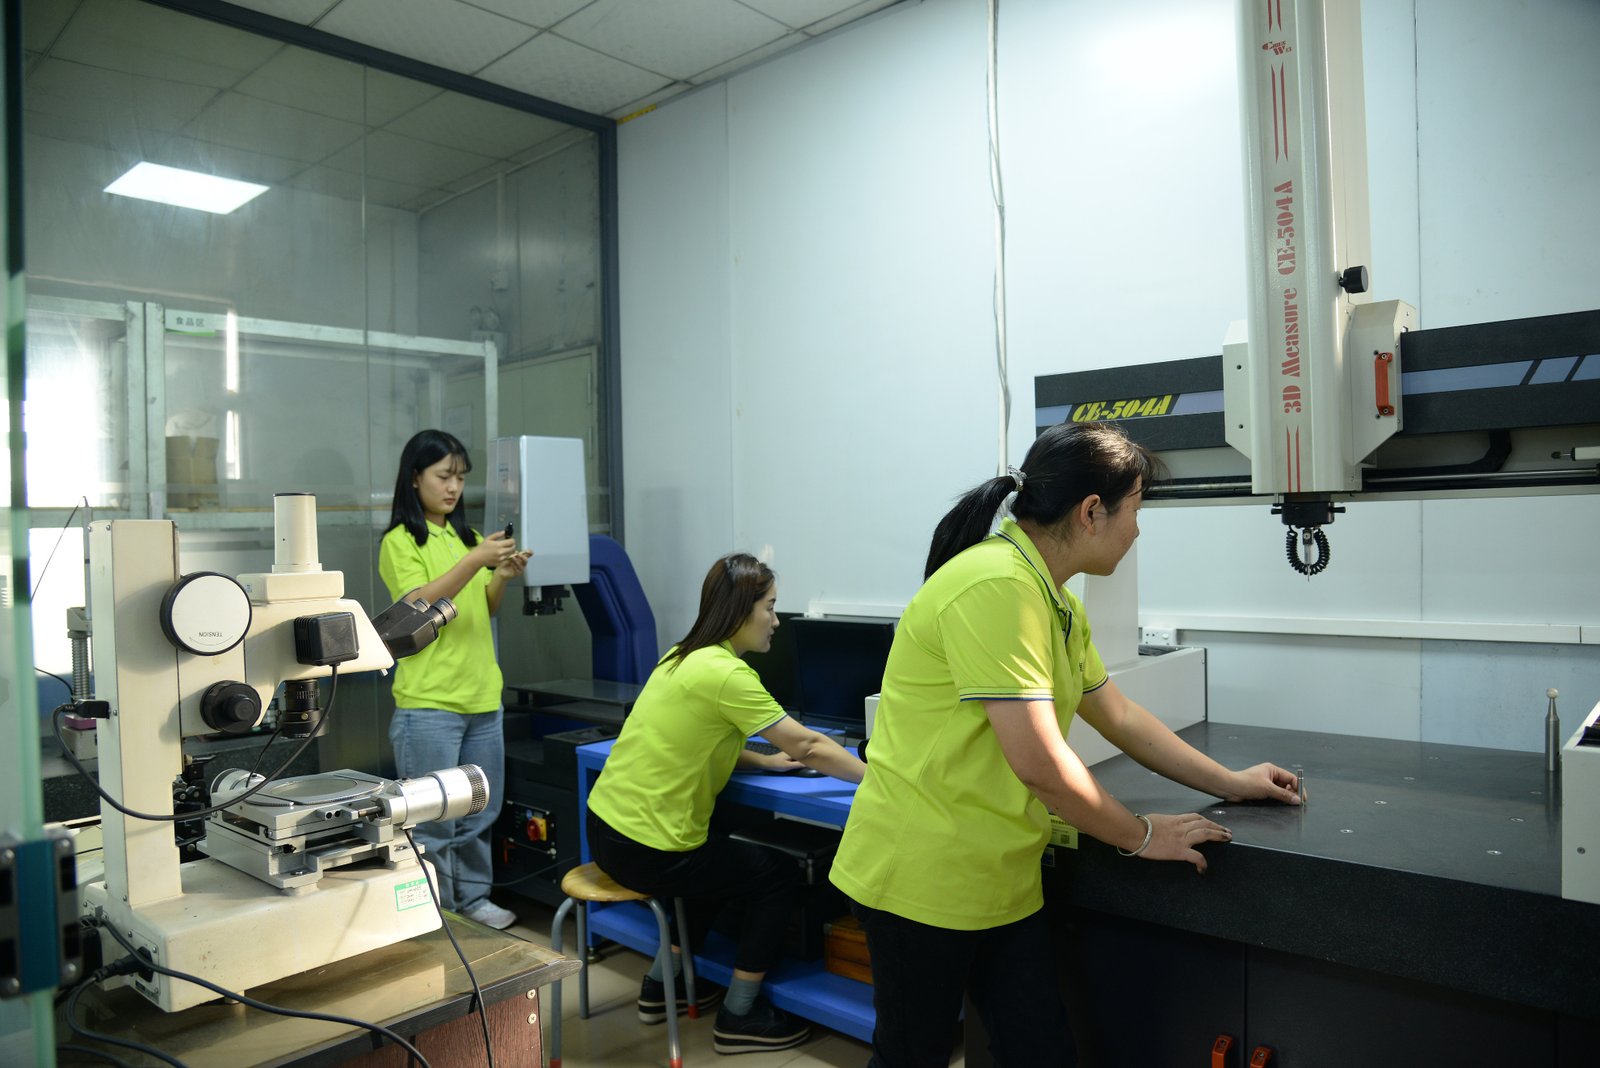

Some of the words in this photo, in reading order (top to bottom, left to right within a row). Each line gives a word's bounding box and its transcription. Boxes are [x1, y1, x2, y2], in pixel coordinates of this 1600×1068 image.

[1274, 180, 1296, 275] CE-504A
[1281, 287, 1301, 377] Measure
[1072, 394, 1173, 422] CE-504A
[1282, 385, 1301, 414] 3D
